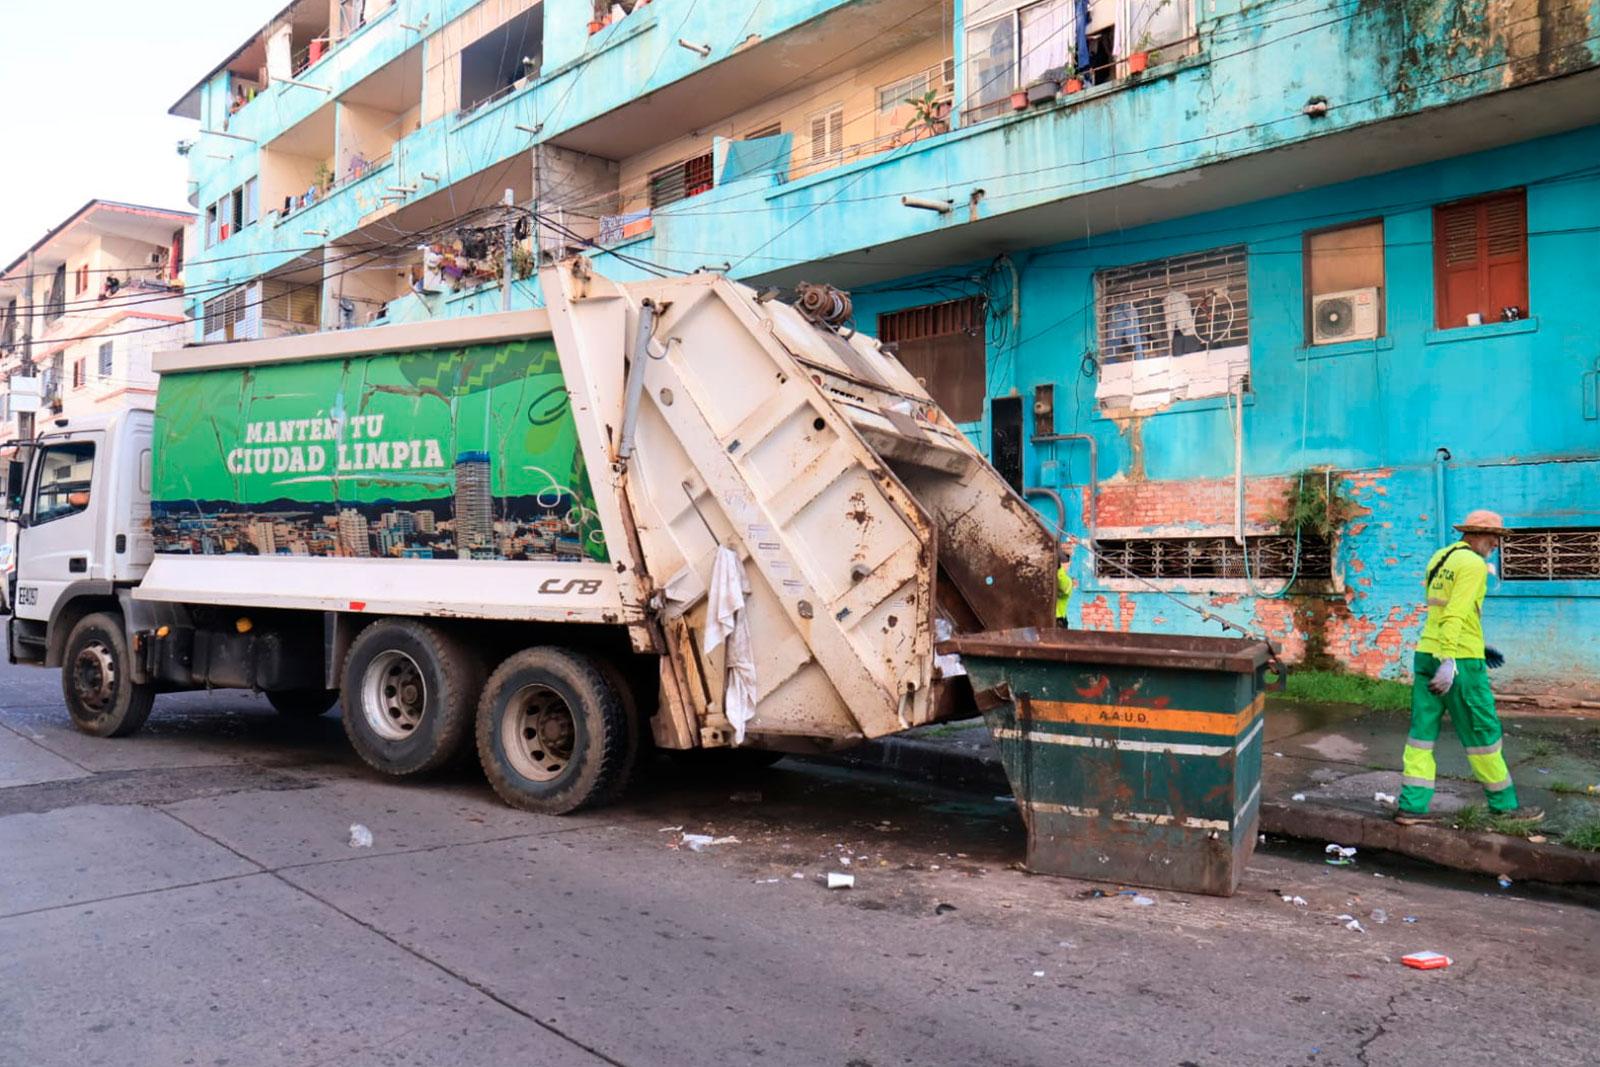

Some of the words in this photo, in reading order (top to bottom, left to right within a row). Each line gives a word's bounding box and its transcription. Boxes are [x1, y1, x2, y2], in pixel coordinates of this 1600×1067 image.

[246, 410, 340, 443] MANTÉN
[350, 414, 384, 439] TU
[227, 445, 325, 474] CIUDAD
[337, 439, 444, 471] LIMPIA
